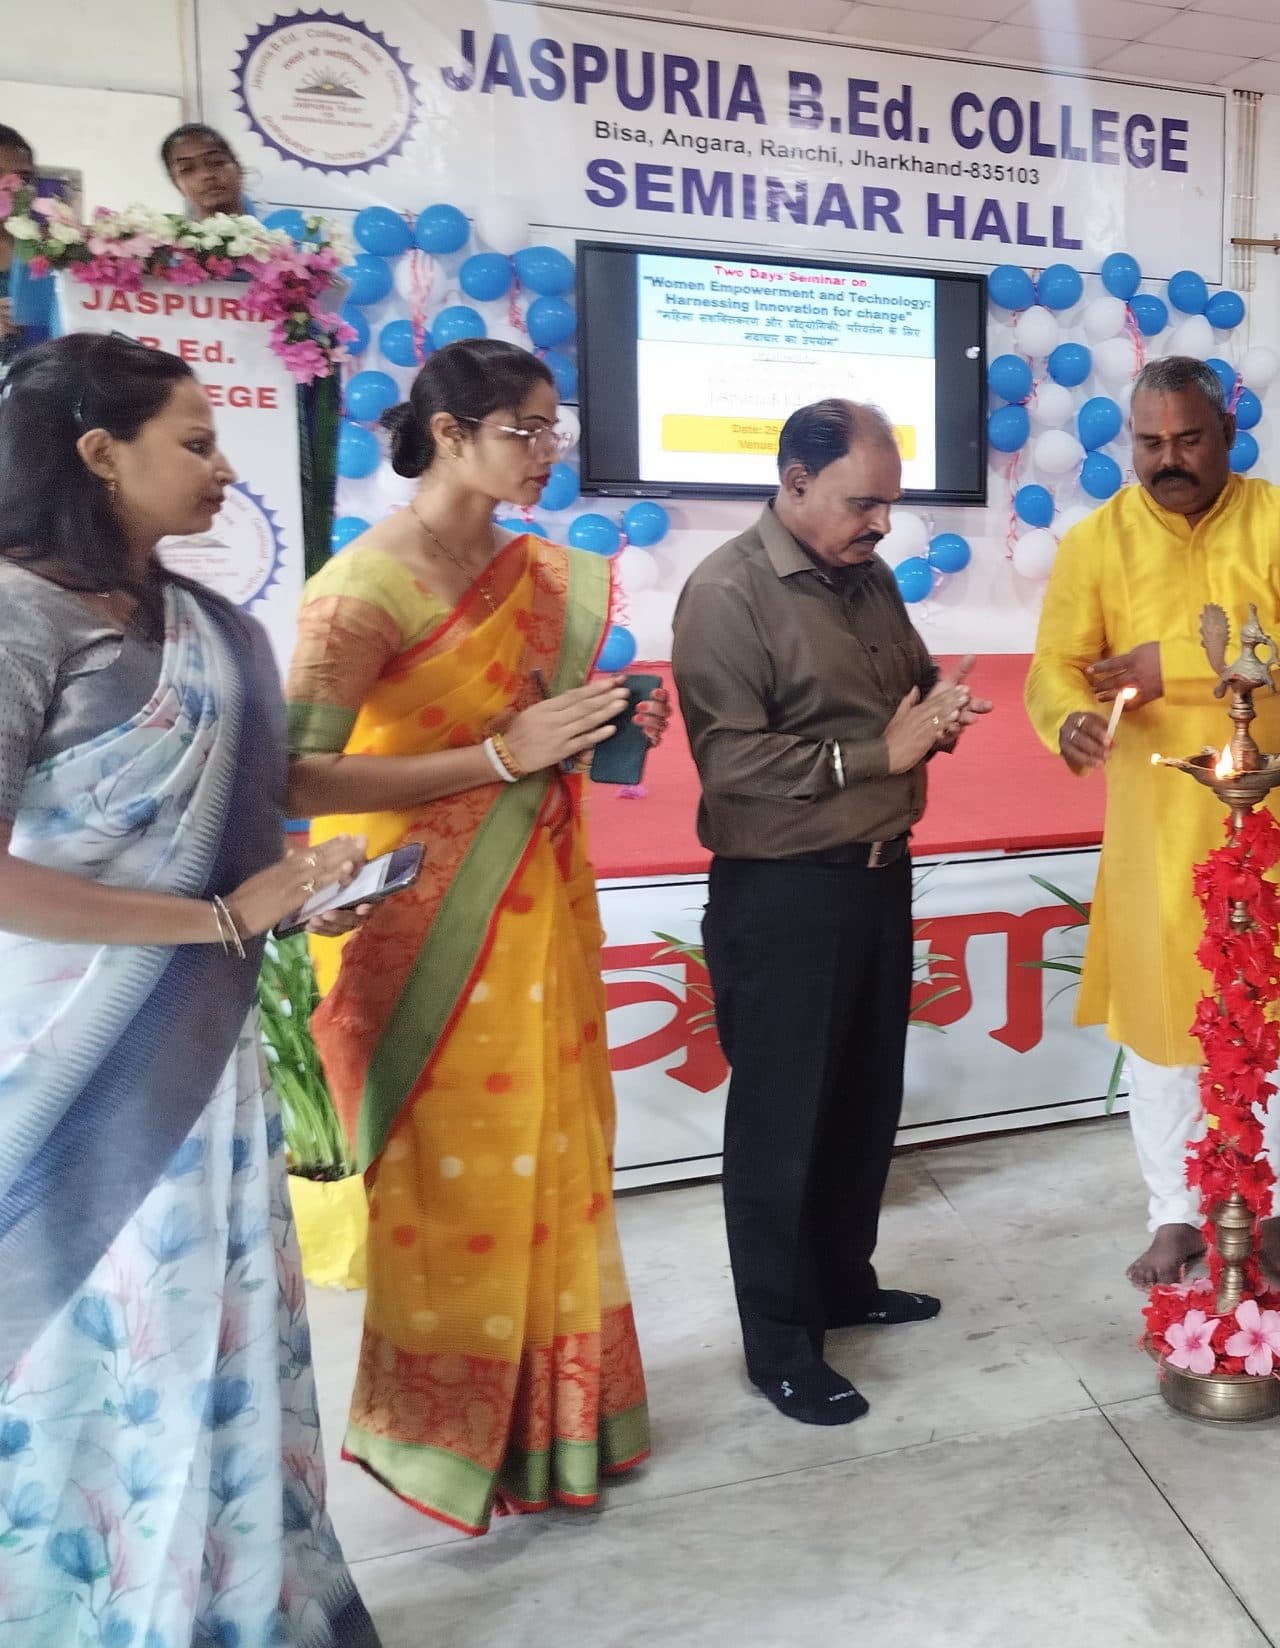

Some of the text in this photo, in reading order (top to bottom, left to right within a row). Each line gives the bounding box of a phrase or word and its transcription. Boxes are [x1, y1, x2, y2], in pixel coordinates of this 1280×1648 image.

[439, 28, 768, 126] JASPURIA
[787, 70, 930, 145] B.Ed.
[950, 91, 1190, 174] COLLEGE
[595, 120, 1040, 185] Bisa, Angara, Ranchi, Jharkhand-835103
[584, 158, 1084, 251] SEMINAR HALL
[714, 265, 867, 288] Two Days Seminar on
[82, 287, 275, 323] JASPUR
[665, 293, 749, 312] Harnessing
[755, 300, 829, 316] Innovation
[833, 306, 853, 317] for
[710, 280, 815, 300] Empowerment
[819, 290, 845, 301] and
[849, 292, 931, 310] Technology:
